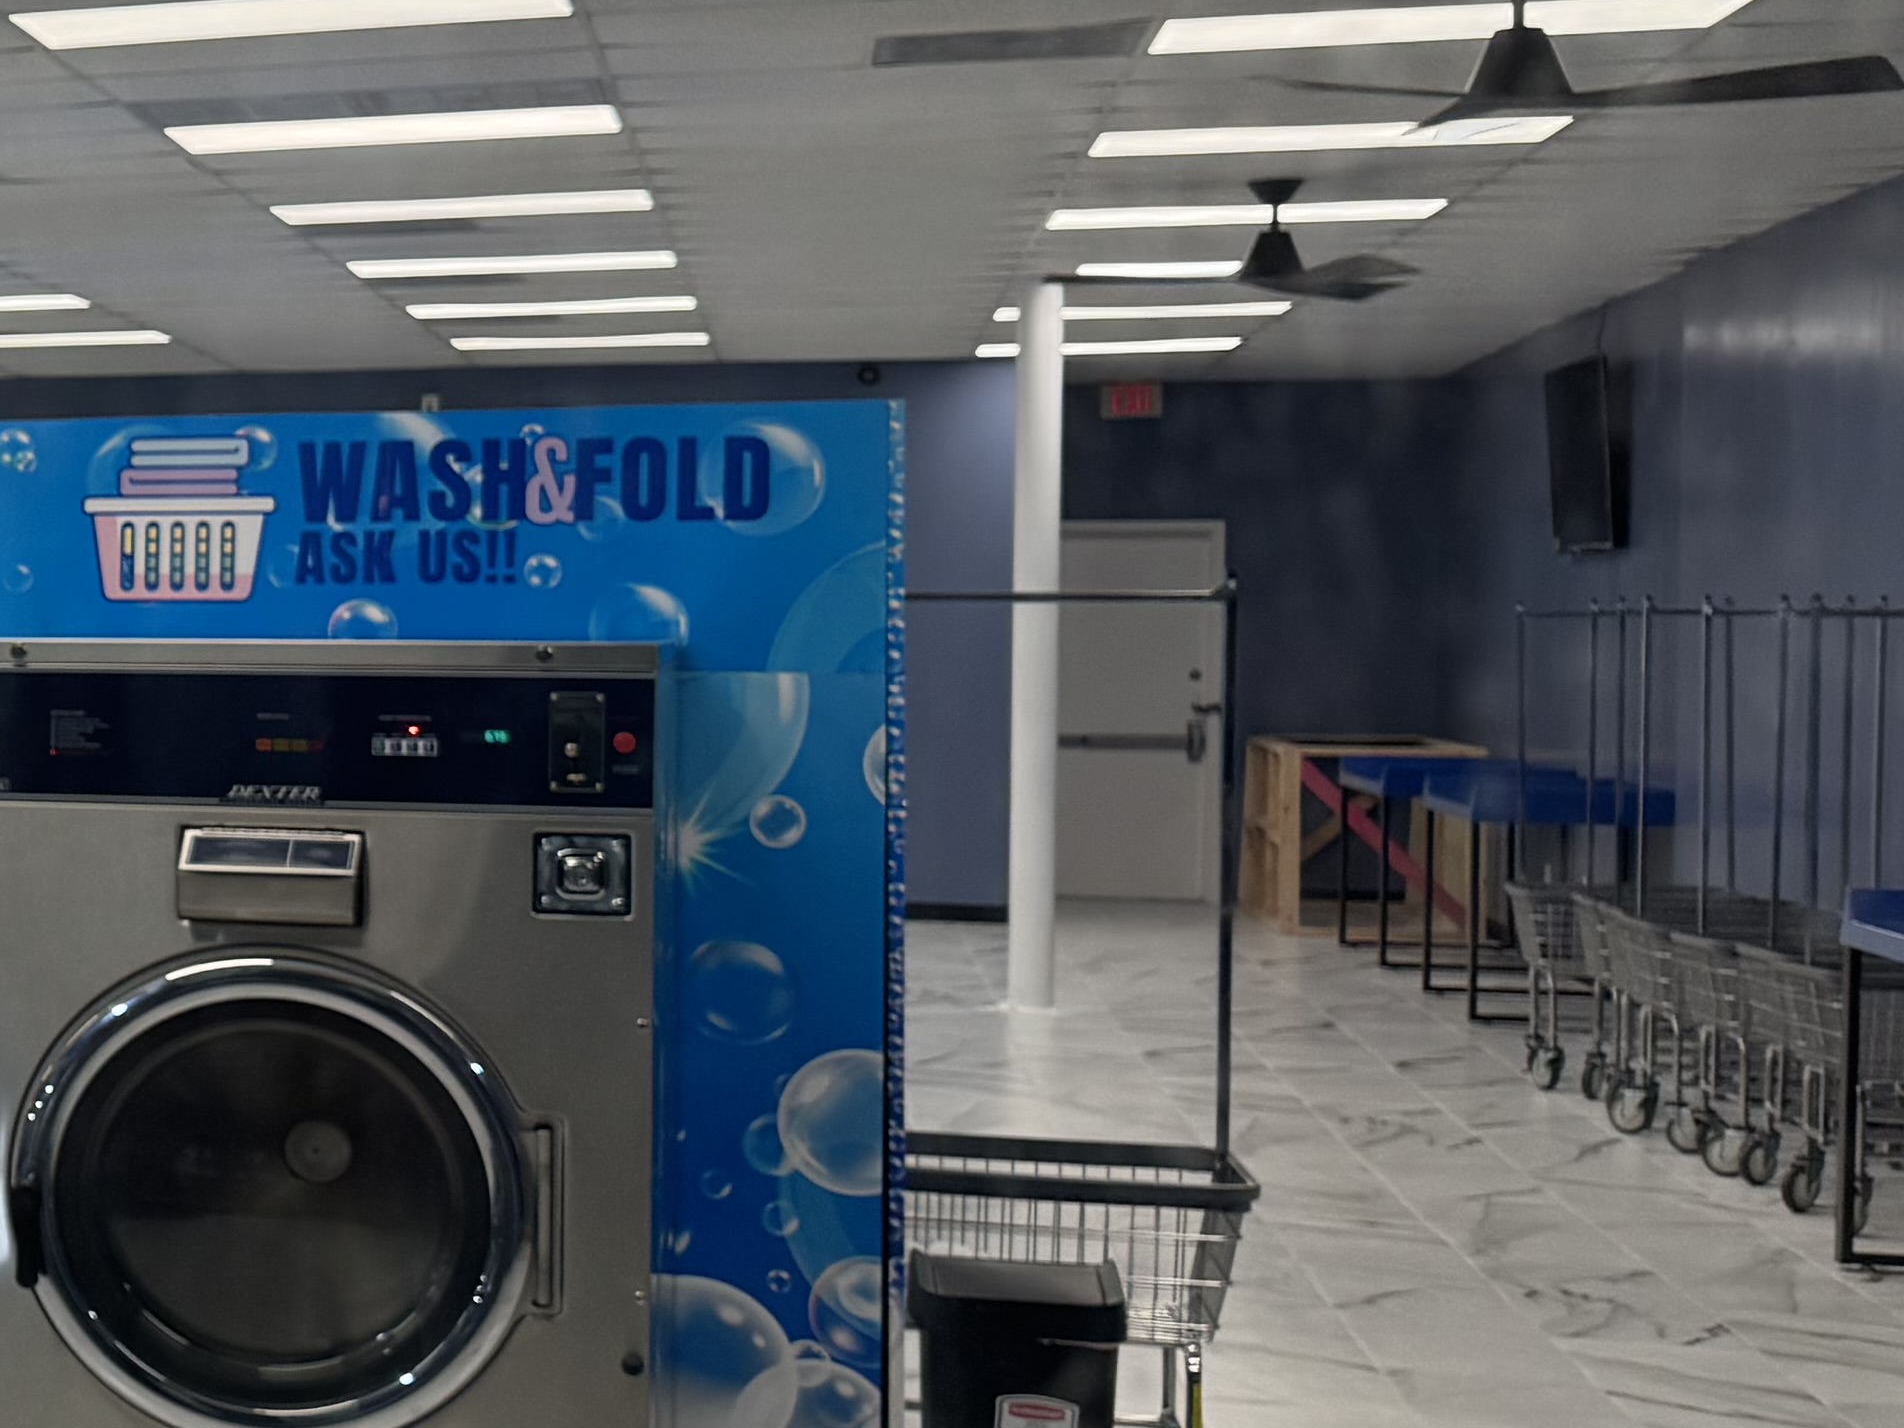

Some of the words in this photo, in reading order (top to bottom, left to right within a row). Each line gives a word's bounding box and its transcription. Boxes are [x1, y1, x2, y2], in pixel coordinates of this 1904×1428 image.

[298, 435, 771, 525] WASH&FOLD
[294, 529, 398, 585] ASK
[417, 527, 518, 584] US!!
[226, 784, 322, 801] DEXTER
